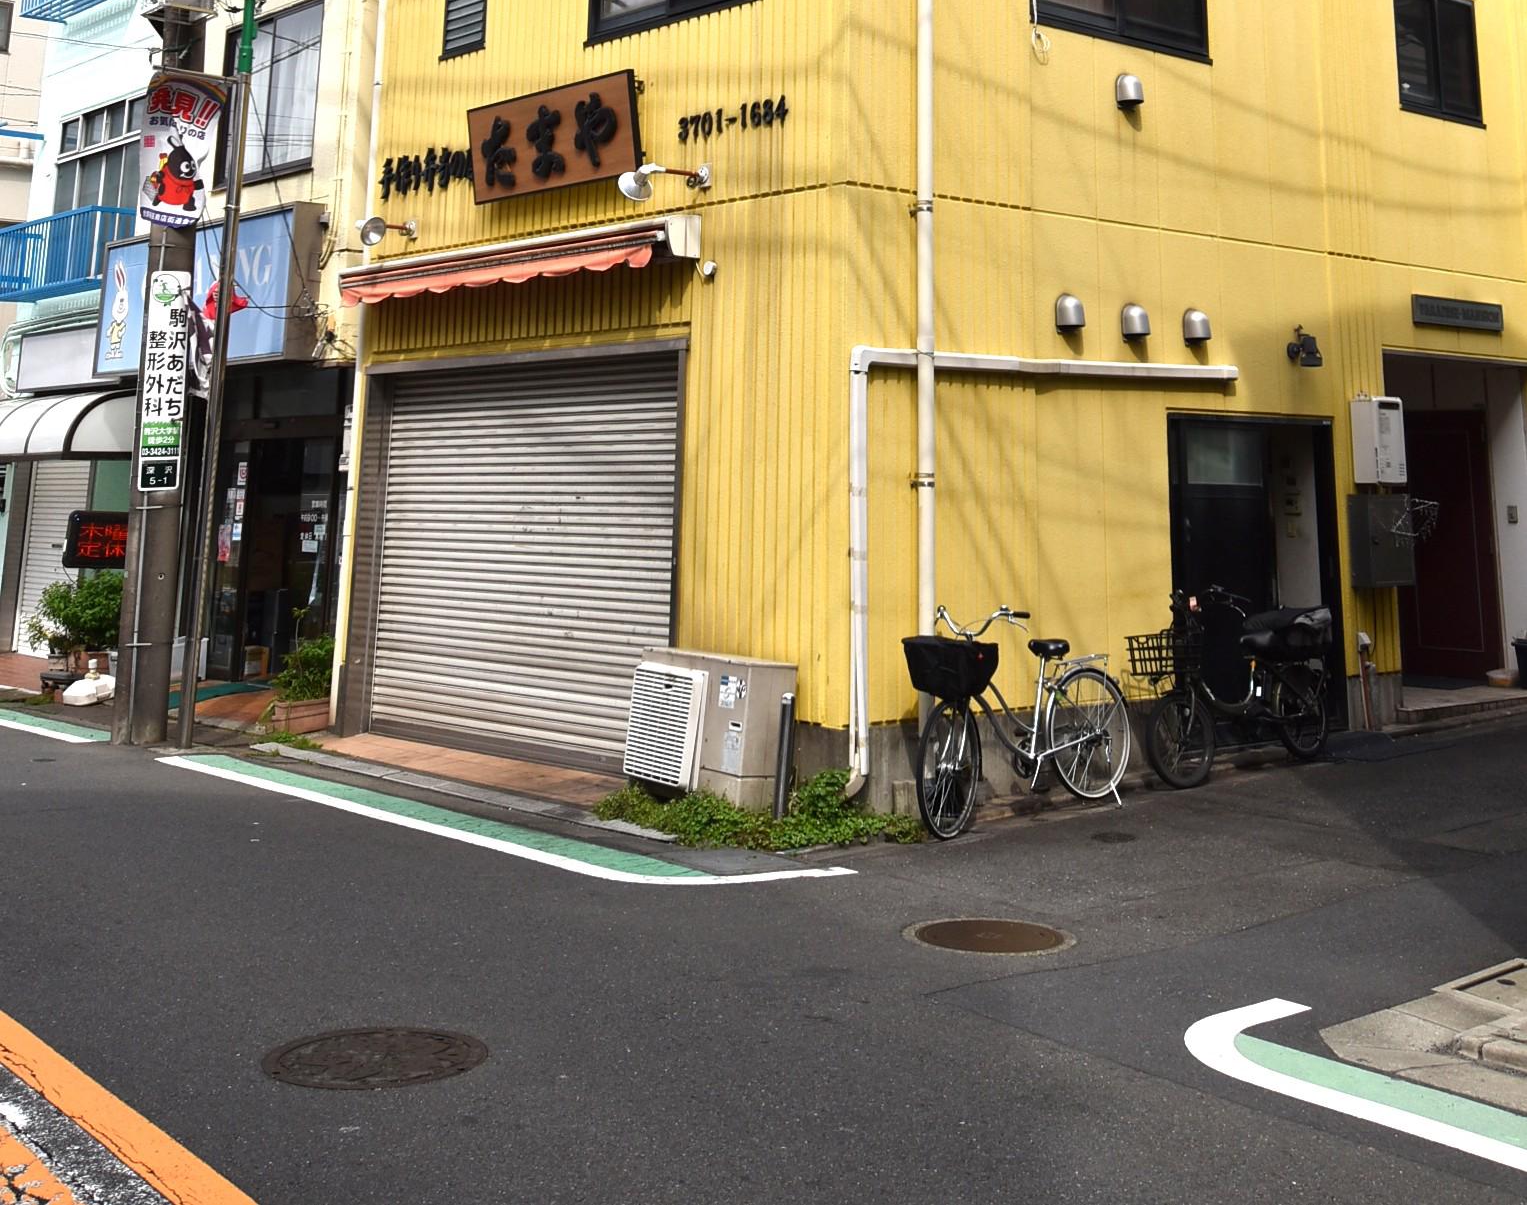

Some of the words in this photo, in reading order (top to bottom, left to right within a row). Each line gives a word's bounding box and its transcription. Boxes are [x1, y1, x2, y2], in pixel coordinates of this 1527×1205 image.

[481, 92, 617, 189] たまや
[678, 94, 788, 141] 3701-1684
[144, 330, 167, 417] 整形外科
[165, 308, 187, 417] 駒沢あだち
[149, 476, 168, 485] 5-1
